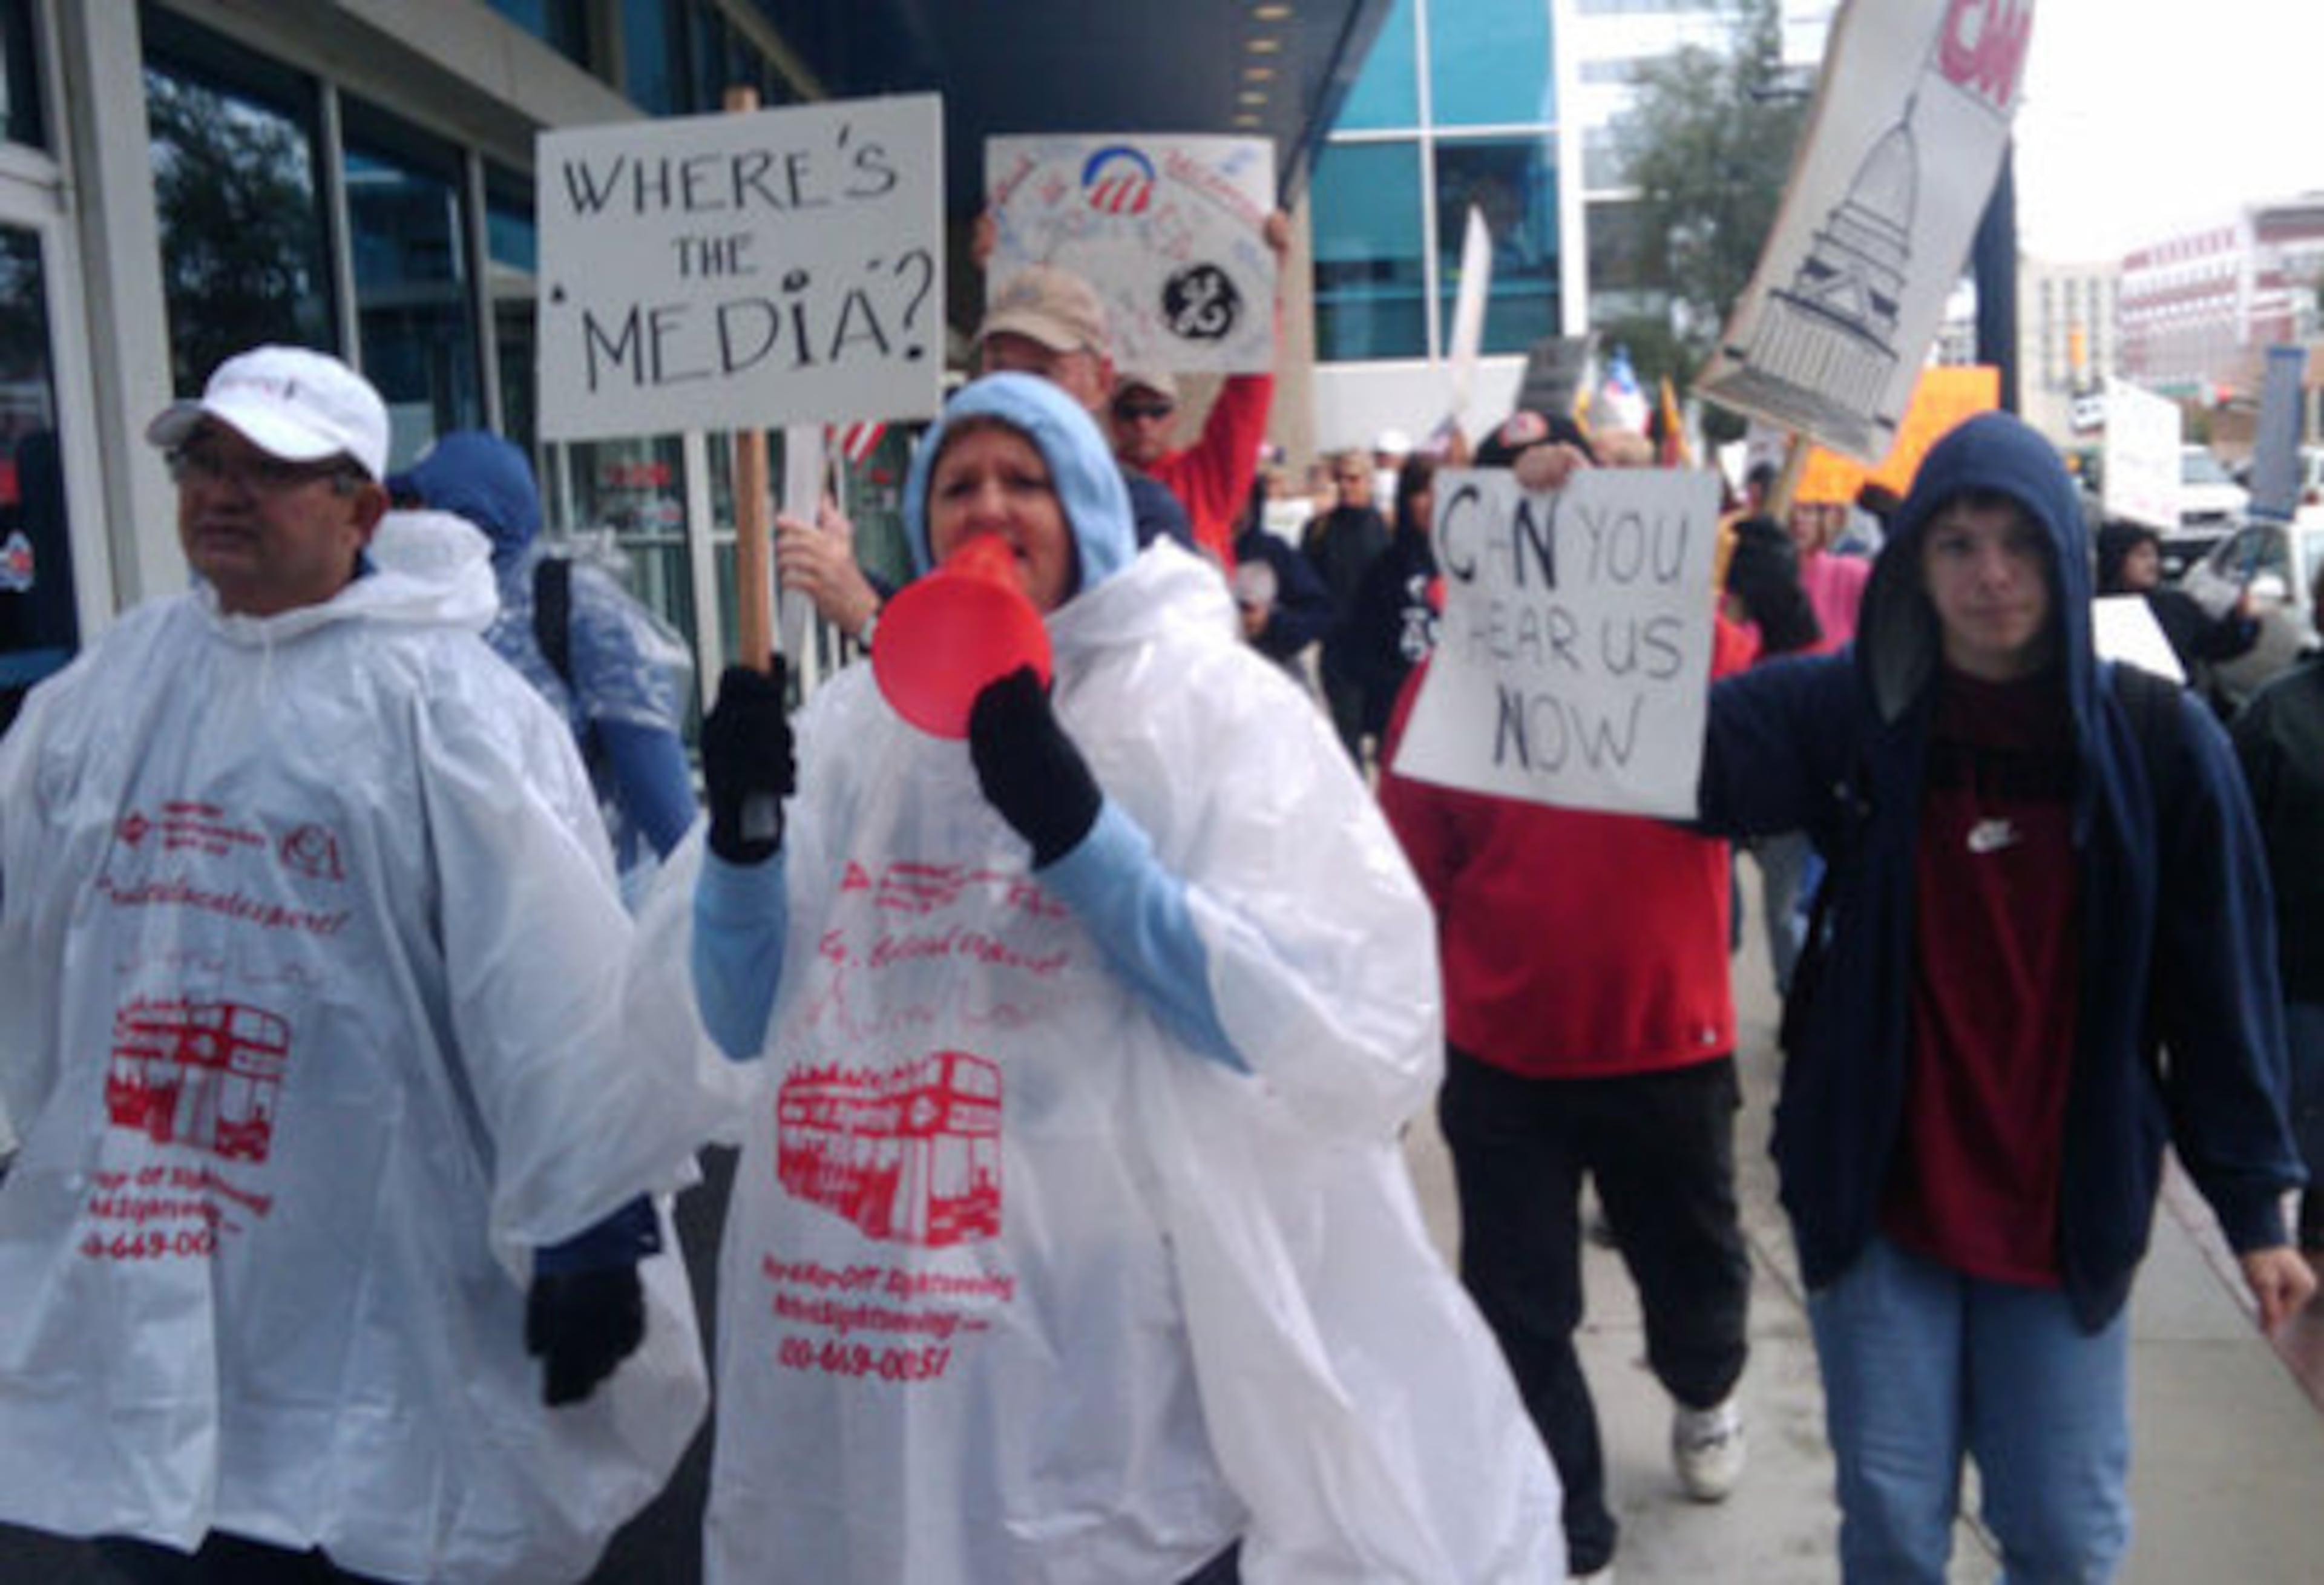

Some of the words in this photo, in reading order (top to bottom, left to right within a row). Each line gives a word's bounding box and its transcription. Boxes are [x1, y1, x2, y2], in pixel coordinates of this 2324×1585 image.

[563, 123, 898, 215] WHERE'S
[672, 232, 760, 278] THE
[1439, 484, 1561, 592] CAN
[1575, 501, 1689, 586] YOU
[1600, 614, 1685, 680] US
[1491, 680, 1645, 775] NOW
